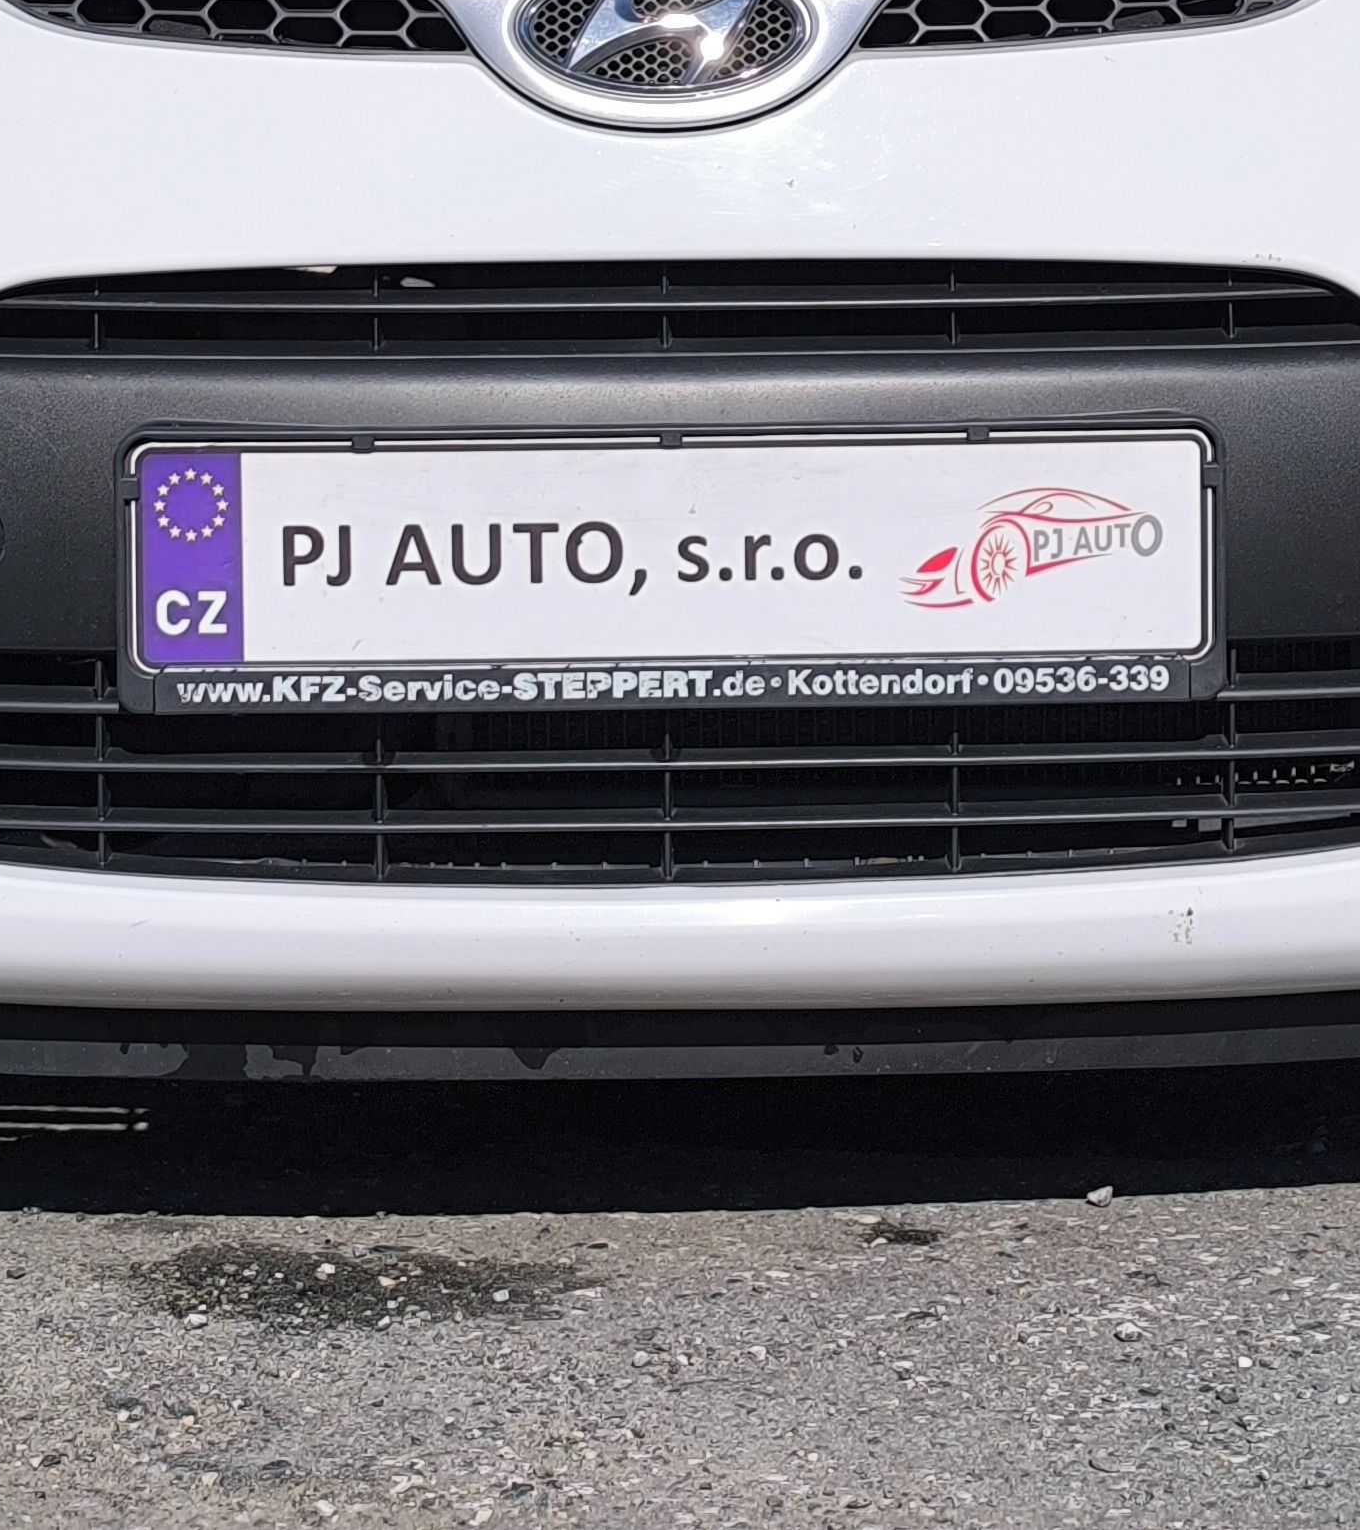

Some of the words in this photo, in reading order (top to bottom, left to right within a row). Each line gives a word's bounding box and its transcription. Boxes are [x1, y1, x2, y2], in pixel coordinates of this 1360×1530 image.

[282, 523, 352, 587] PJ
[385, 520, 648, 597] AUTO,
[676, 532, 863, 583] s.r.o.
[1033, 527, 1064, 563] PJ
[1072, 514, 1164, 557] AUTO
[155, 589, 228, 636] CZ
[175, 668, 767, 704] www.KFZ-Service-STEPPERT.de
[786, 666, 975, 696] Kottendorf
[992, 663, 1171, 694] 09536-339
